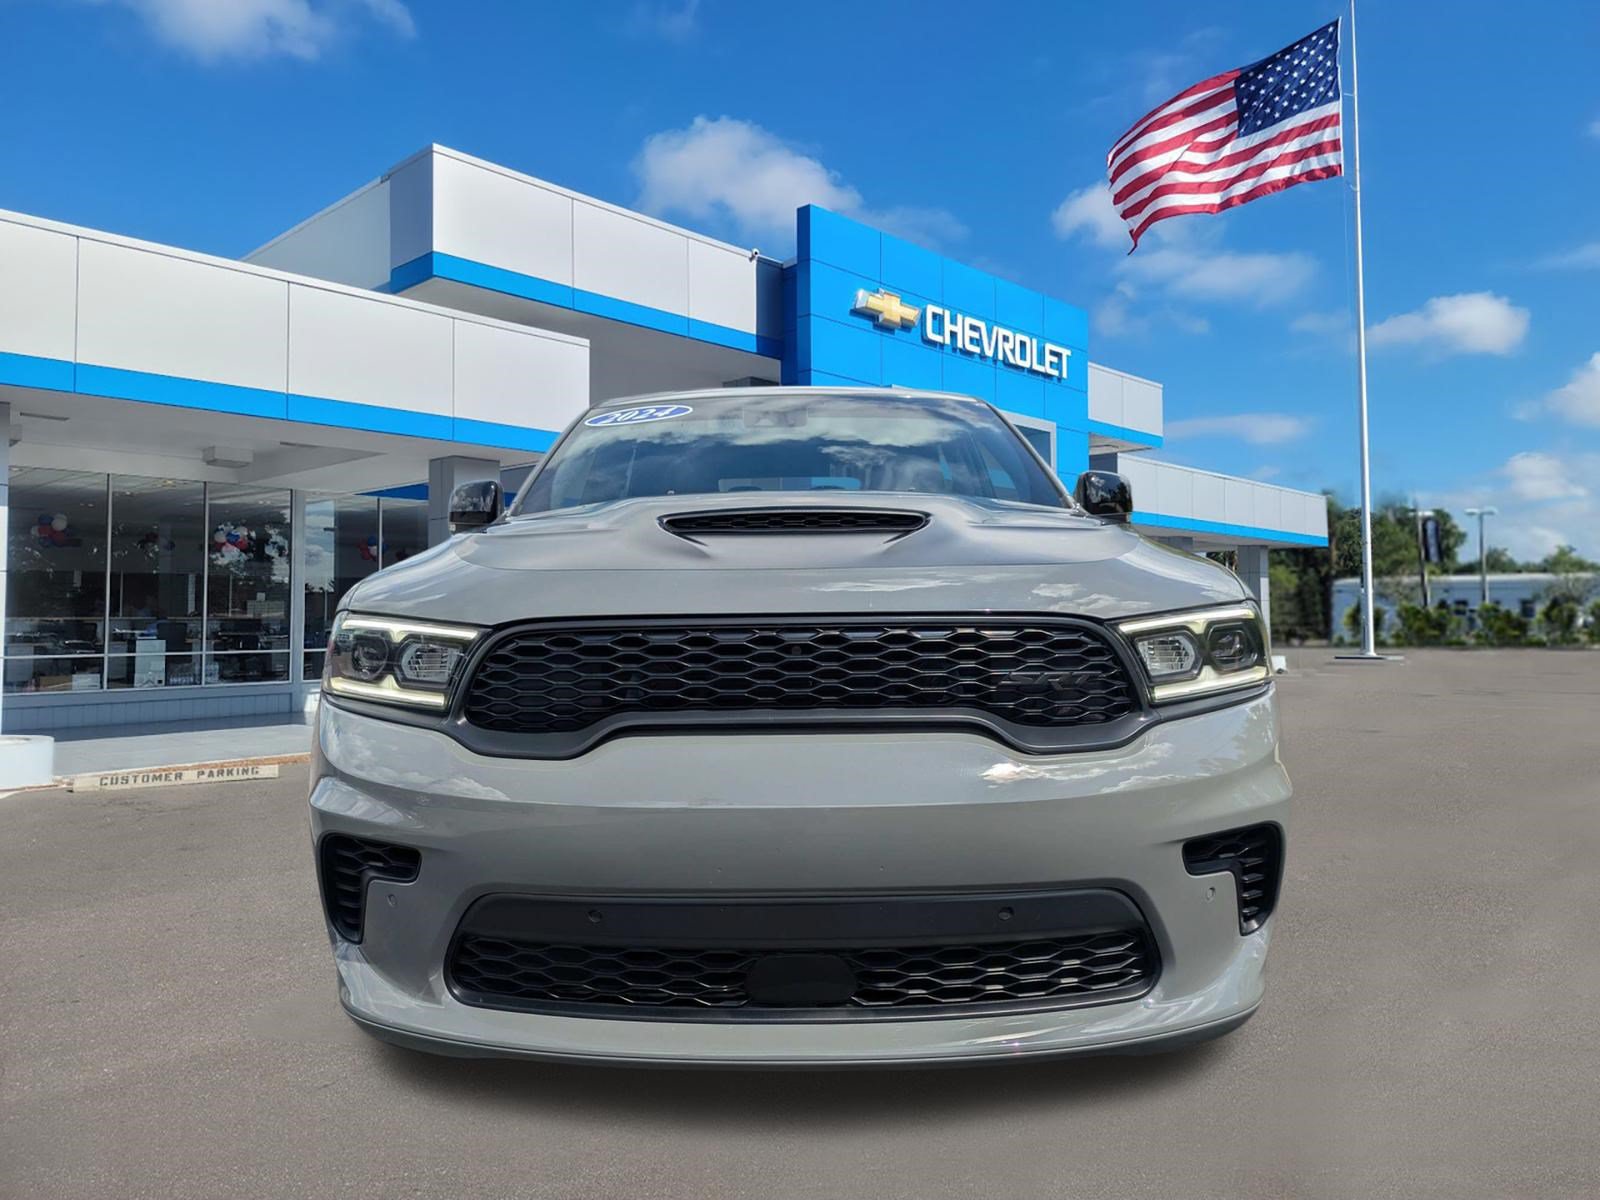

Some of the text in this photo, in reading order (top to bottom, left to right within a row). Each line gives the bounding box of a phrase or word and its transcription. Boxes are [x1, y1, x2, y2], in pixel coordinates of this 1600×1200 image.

[925, 304, 1071, 379] CHEVROLET
[599, 405, 678, 423] 2024
[99, 766, 259, 786] CUSTOMER PARKING
